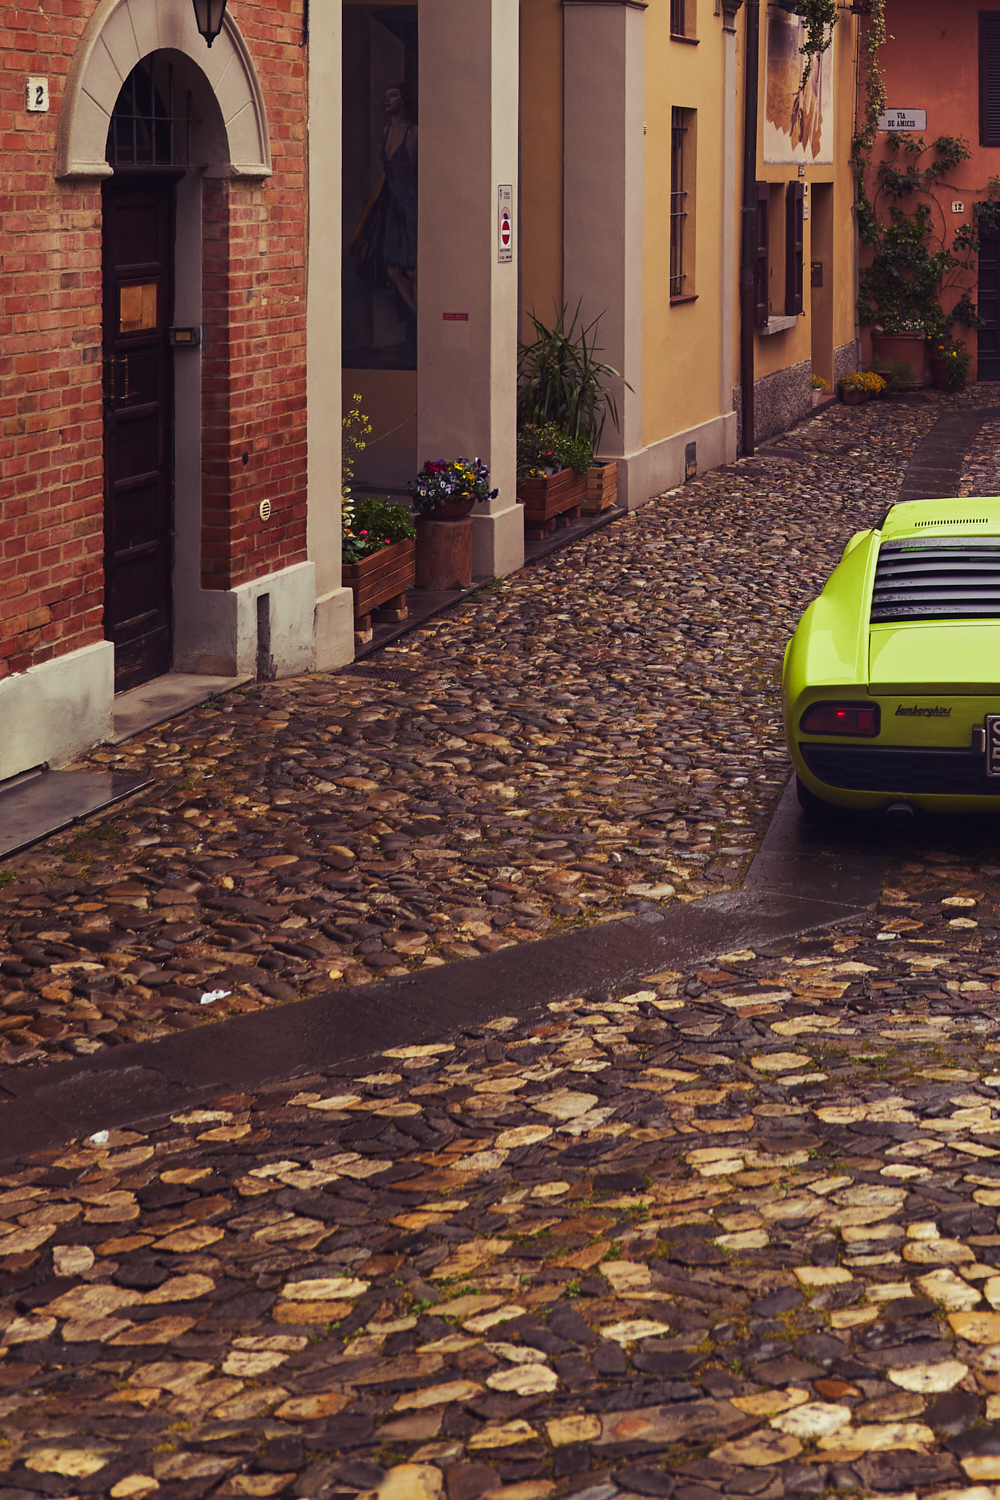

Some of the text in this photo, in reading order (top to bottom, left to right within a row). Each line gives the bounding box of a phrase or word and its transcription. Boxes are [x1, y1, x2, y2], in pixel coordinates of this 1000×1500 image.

[35, 85, 44, 105] 2
[954, 203, 963, 211] 12
[894, 704, 952, 717] Lamborghini
